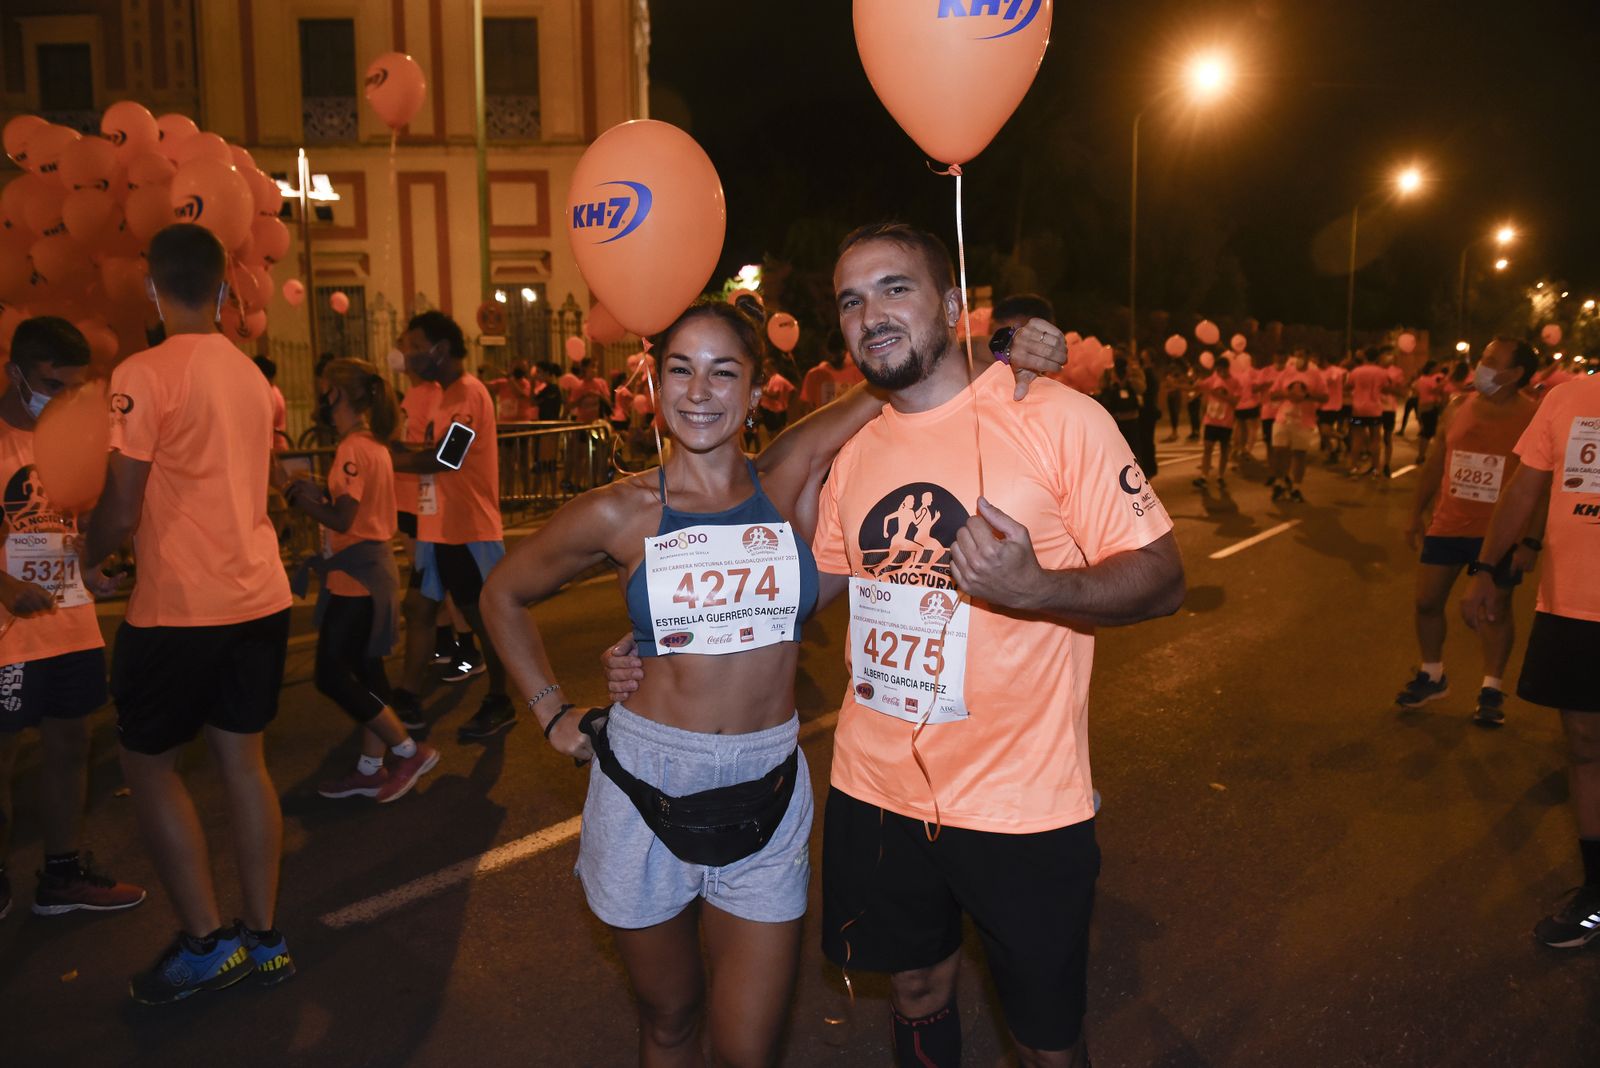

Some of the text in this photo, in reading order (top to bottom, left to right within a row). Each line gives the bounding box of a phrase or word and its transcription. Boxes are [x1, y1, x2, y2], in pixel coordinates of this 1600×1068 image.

[1454, 468, 1494, 486] 4282
[21, 559, 76, 582] 5321
[693, 560, 724, 568] NOCTURNA
[672, 565, 780, 609] 4274
[655, 606, 797, 627] ESTRELLA GUERRERO SANCHEZ
[863, 627, 945, 677] 4275
[863, 667, 890, 683] ALBERTO
[890, 674, 918, 689] GARCIA
[919, 681, 947, 694] PEREZ
